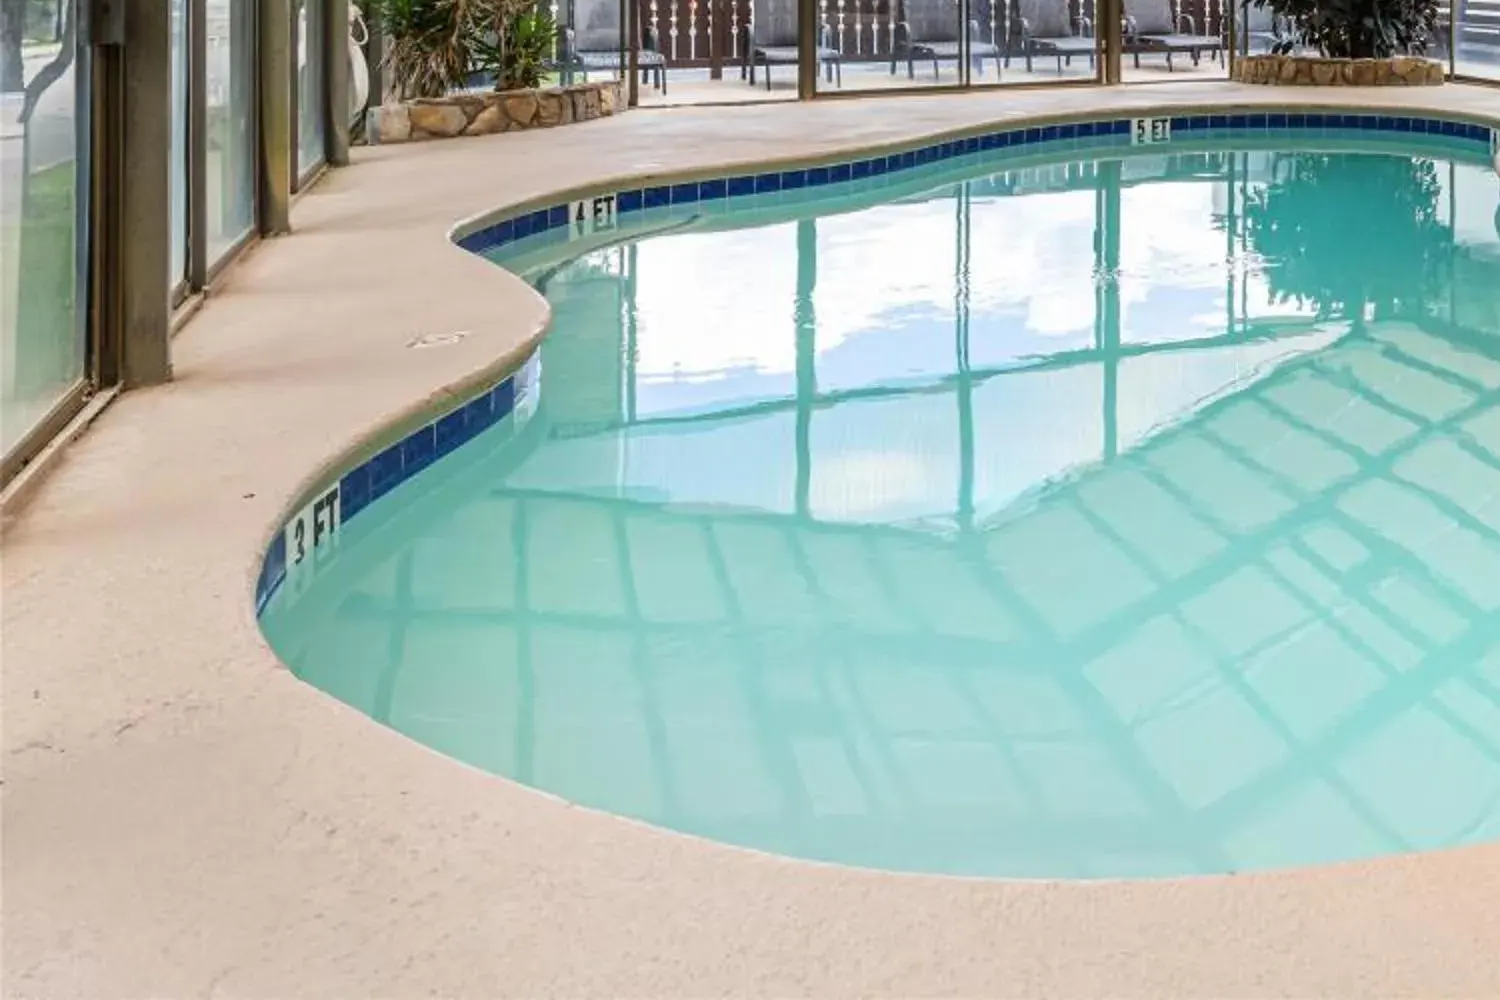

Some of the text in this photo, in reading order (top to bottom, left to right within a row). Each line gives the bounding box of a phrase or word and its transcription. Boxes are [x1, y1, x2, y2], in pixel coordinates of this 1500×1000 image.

[1137, 119, 1146, 136] 5
[575, 195, 614, 221] 4 FT
[294, 487, 339, 567] 3 FT
